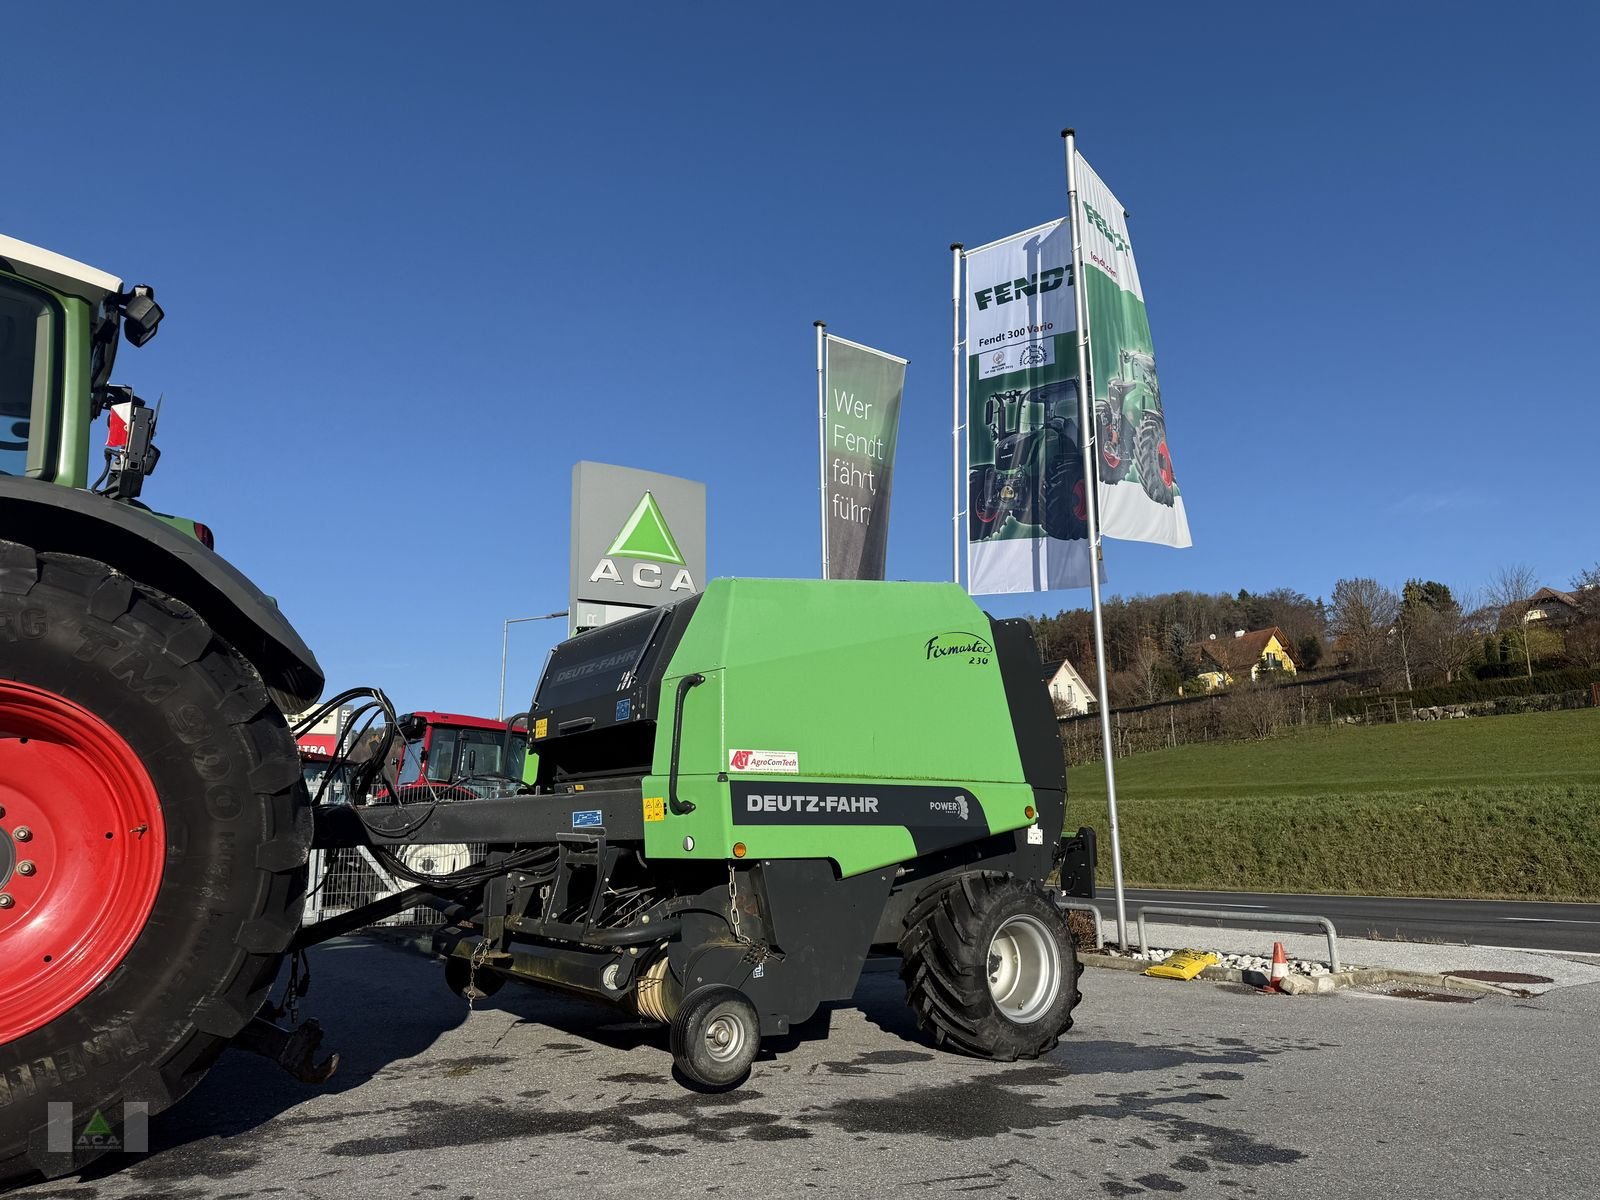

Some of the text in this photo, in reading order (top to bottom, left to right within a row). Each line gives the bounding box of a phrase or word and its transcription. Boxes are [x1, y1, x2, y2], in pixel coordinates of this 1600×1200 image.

[974, 261, 1083, 311] FENDT
[979, 321, 1054, 347] Fendt 300 Vario
[834, 388, 873, 420] Wer
[834, 424, 884, 461] Fendt
[832, 458, 877, 496] fährt,
[588, 558, 698, 595] ACA
[556, 649, 637, 682] DEUTZ-FAHR
[968, 656, 989, 665] 230
[750, 758, 797, 768] AgroComTech
[746, 794, 879, 813] DEUTZ-FAHR
[929, 801, 957, 811] POWER
